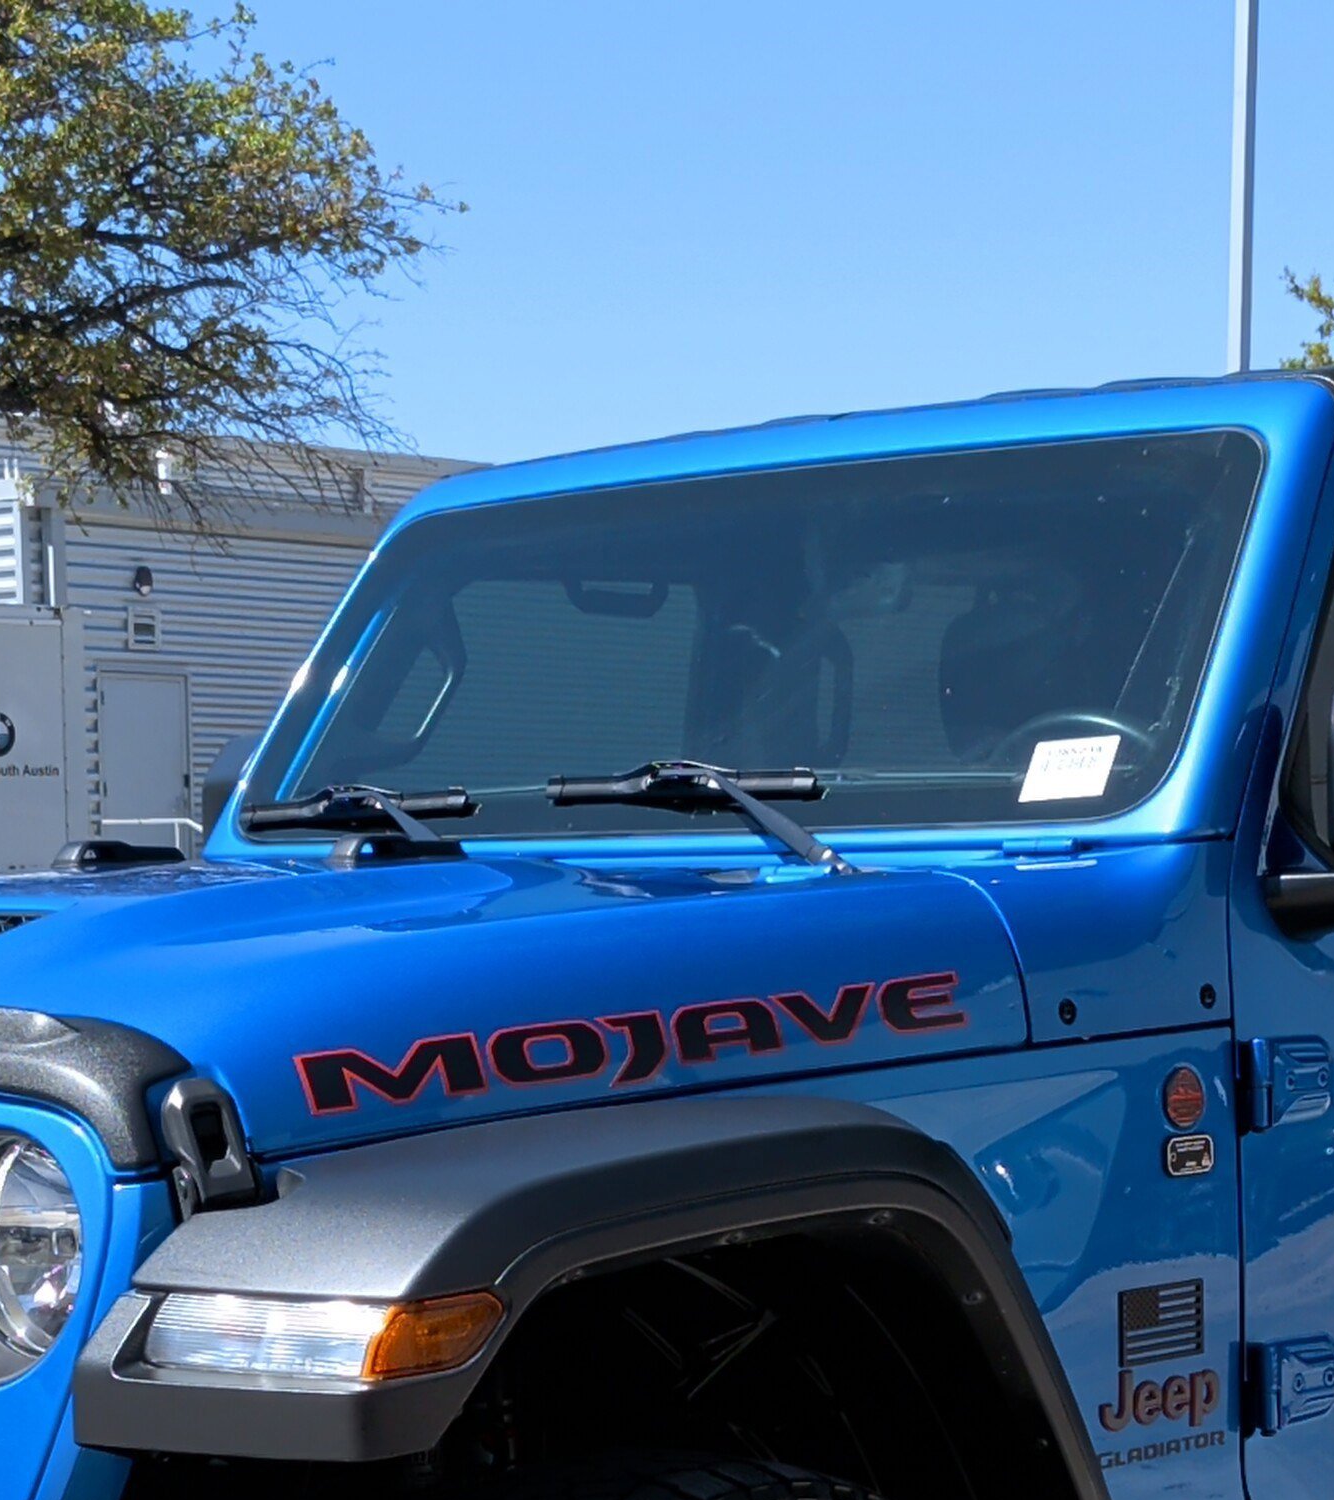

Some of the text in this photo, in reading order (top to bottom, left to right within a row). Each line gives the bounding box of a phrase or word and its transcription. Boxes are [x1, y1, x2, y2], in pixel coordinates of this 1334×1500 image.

[23, 764, 60, 777] Austin
[293, 970, 967, 1116] MOJAVE
[1098, 1368, 1220, 1433] Jeep
[1096, 1429, 1226, 1470] GLADIATOR
